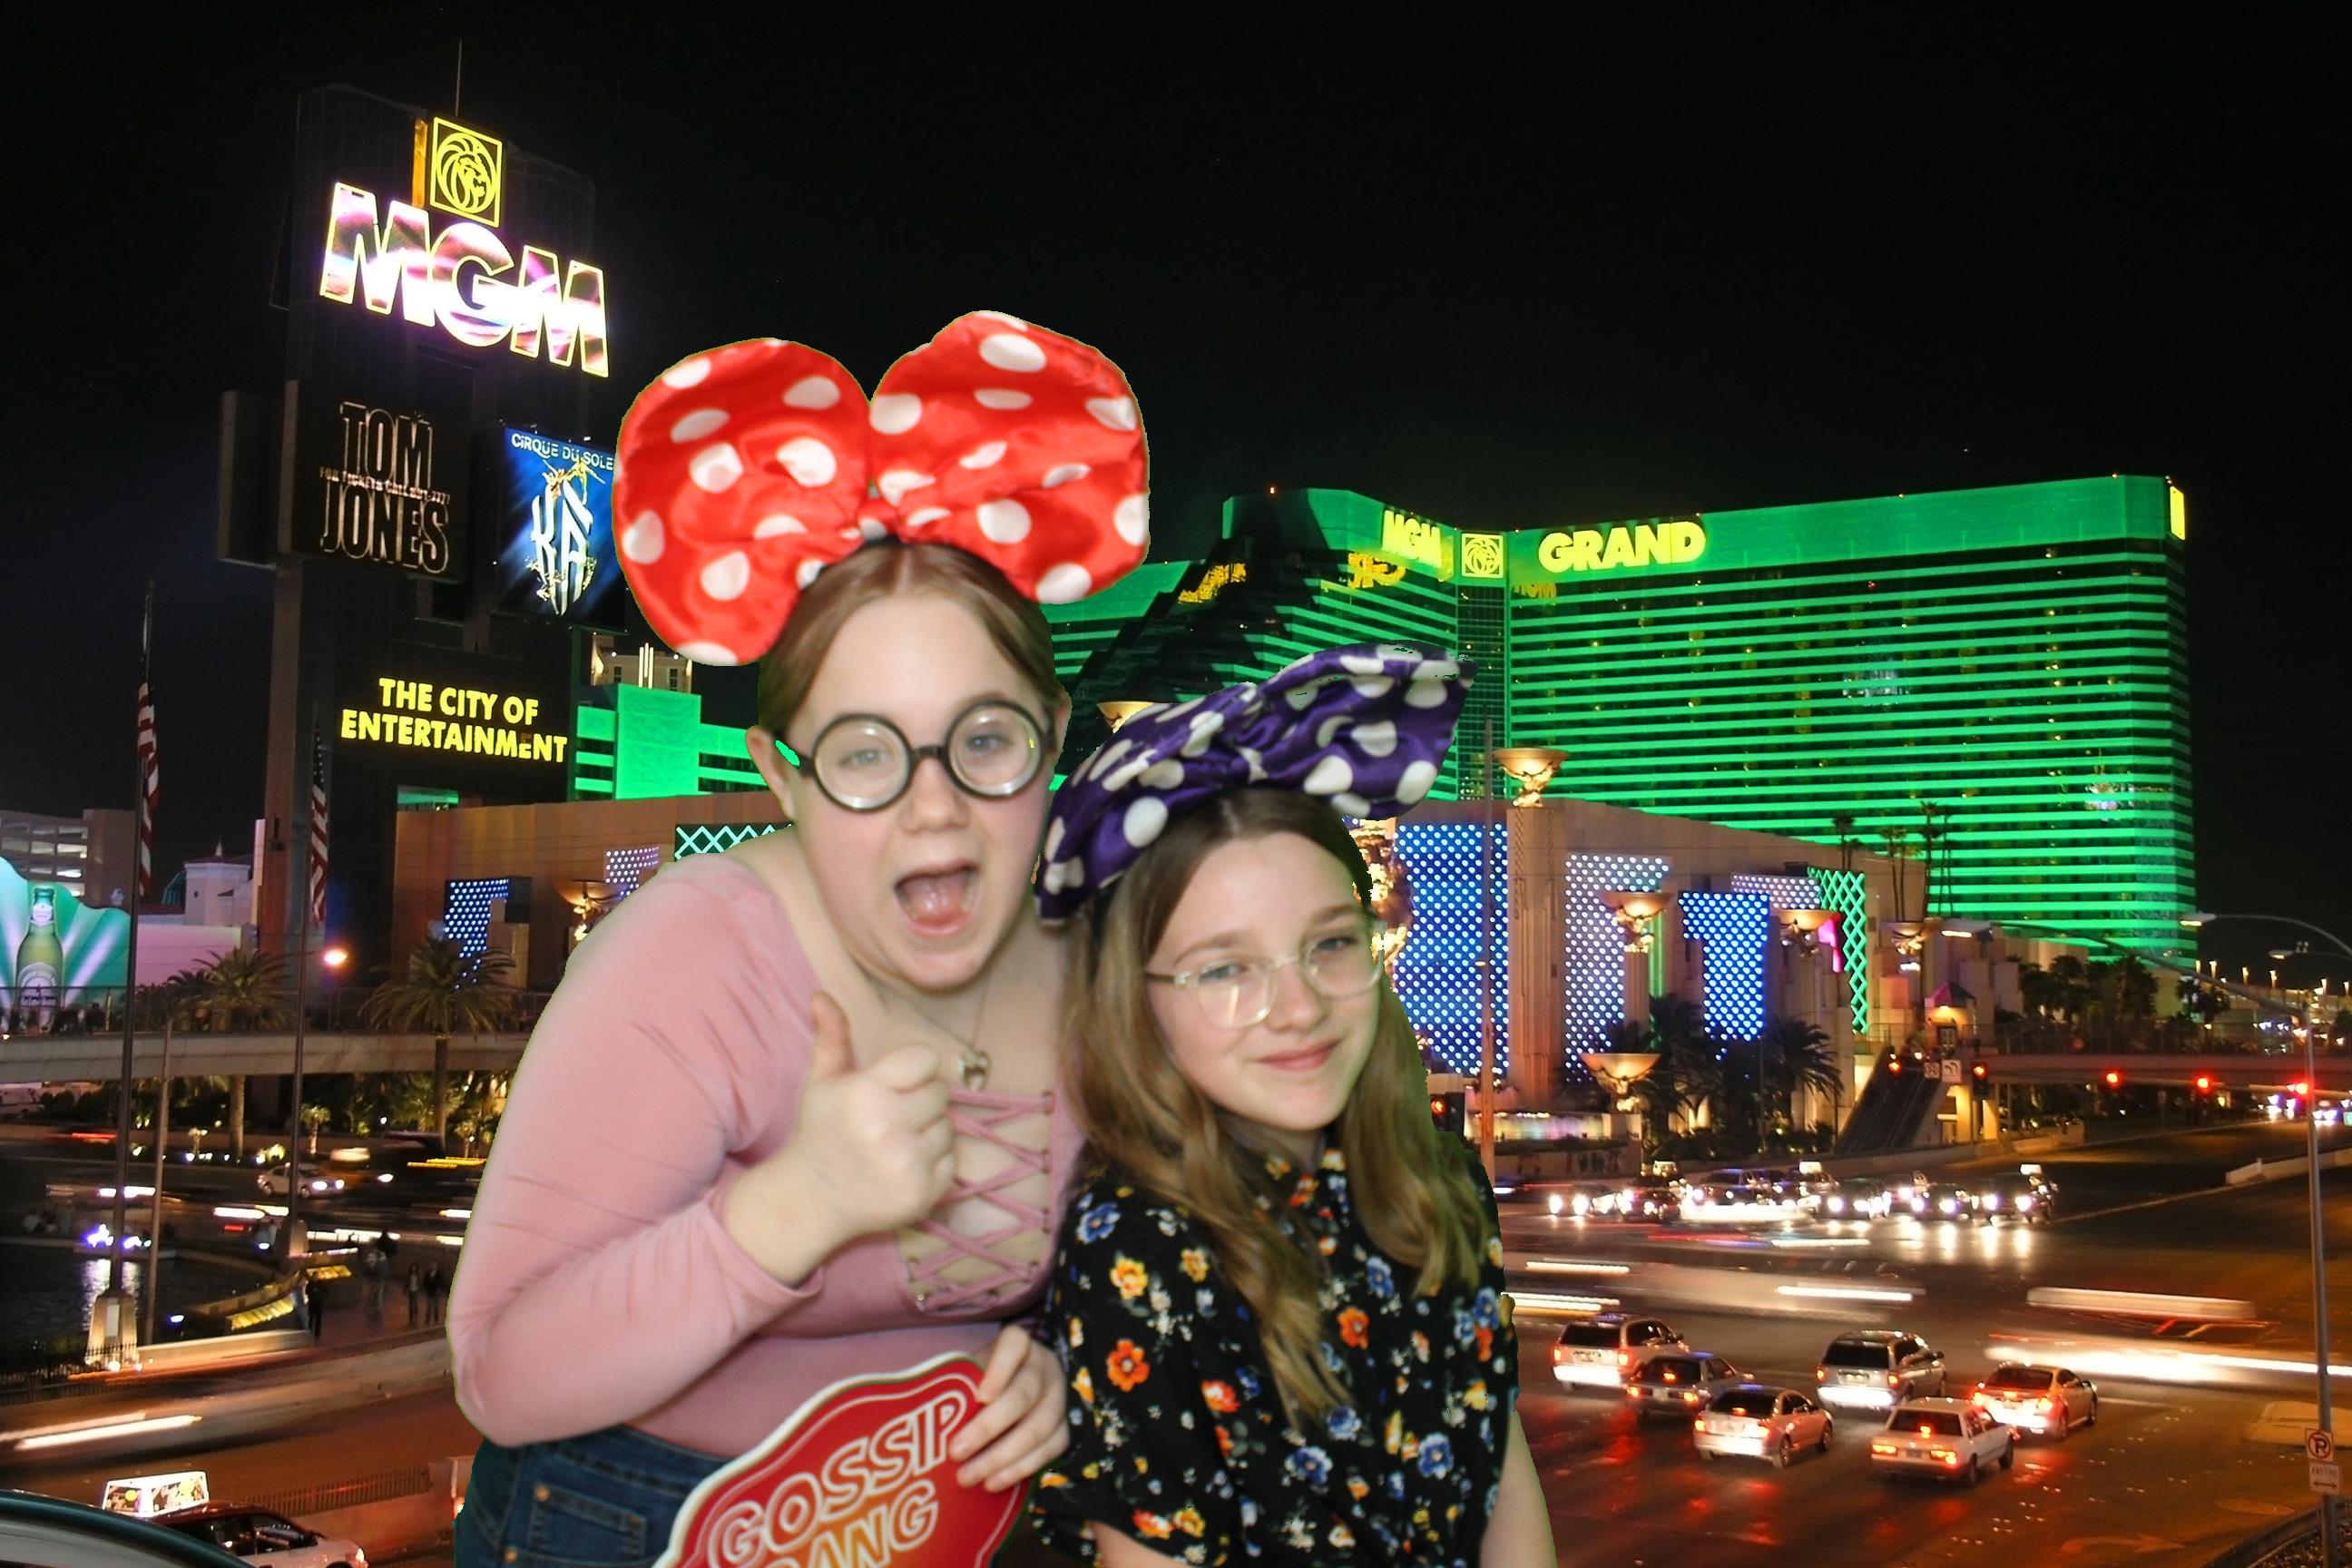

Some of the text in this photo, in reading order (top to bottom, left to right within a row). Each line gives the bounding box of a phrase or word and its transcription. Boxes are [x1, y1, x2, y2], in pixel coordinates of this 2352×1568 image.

[319, 182, 609, 377] MGM
[340, 402, 433, 489] TOM
[583, 451, 614, 471] SOLE
[319, 482, 449, 573] JONES
[1381, 509, 1442, 569] MGM
[1538, 520, 1707, 573] GRAND
[340, 708, 568, 763] ENTERTAINMENT
[378, 677, 540, 726] THE CITY OF
[707, 1390, 968, 1568] GOSSIP
[765, 1479, 940, 1568] ANG
